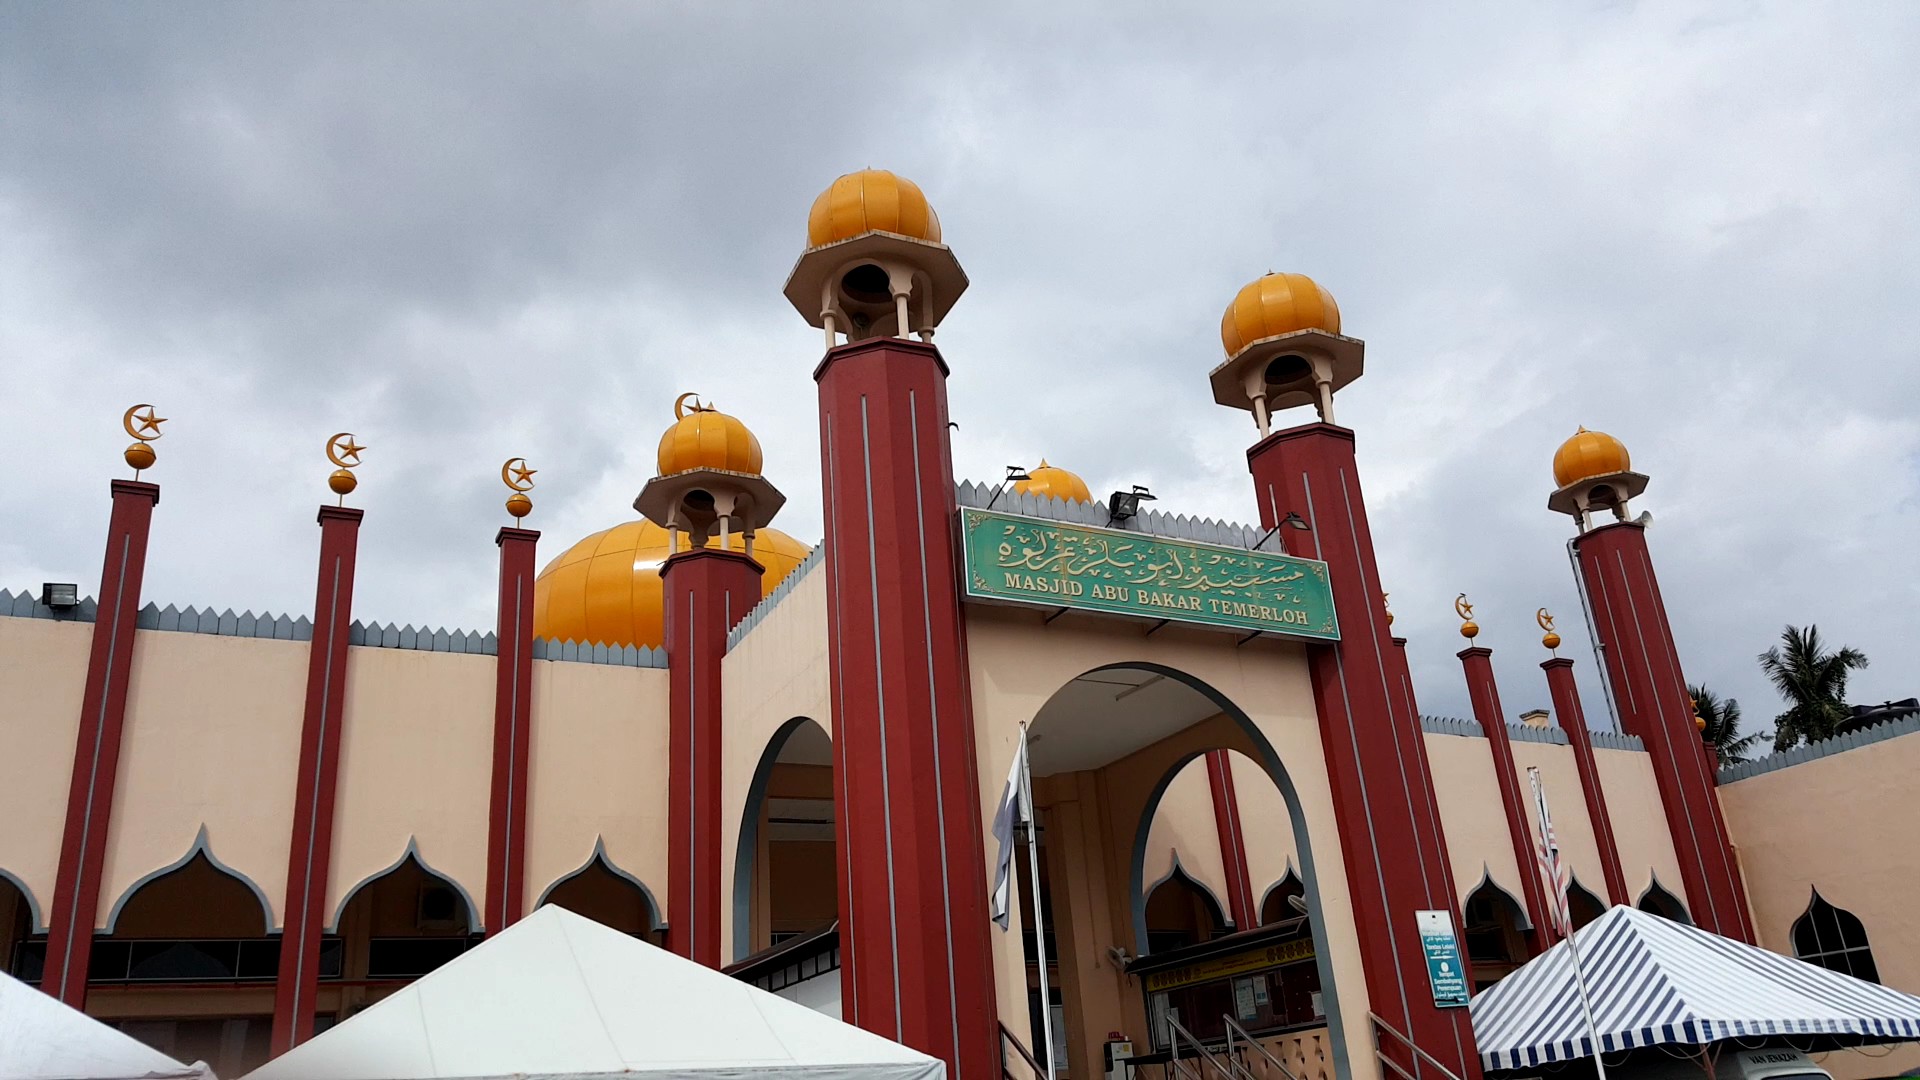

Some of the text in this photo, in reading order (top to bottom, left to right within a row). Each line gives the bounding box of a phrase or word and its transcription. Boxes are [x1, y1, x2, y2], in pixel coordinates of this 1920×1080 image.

[1004, 572, 1309, 626] MASJID ABU BAKAR TEMERLOH
[1748, 1053, 1799, 1064] VAN JENAZAH
